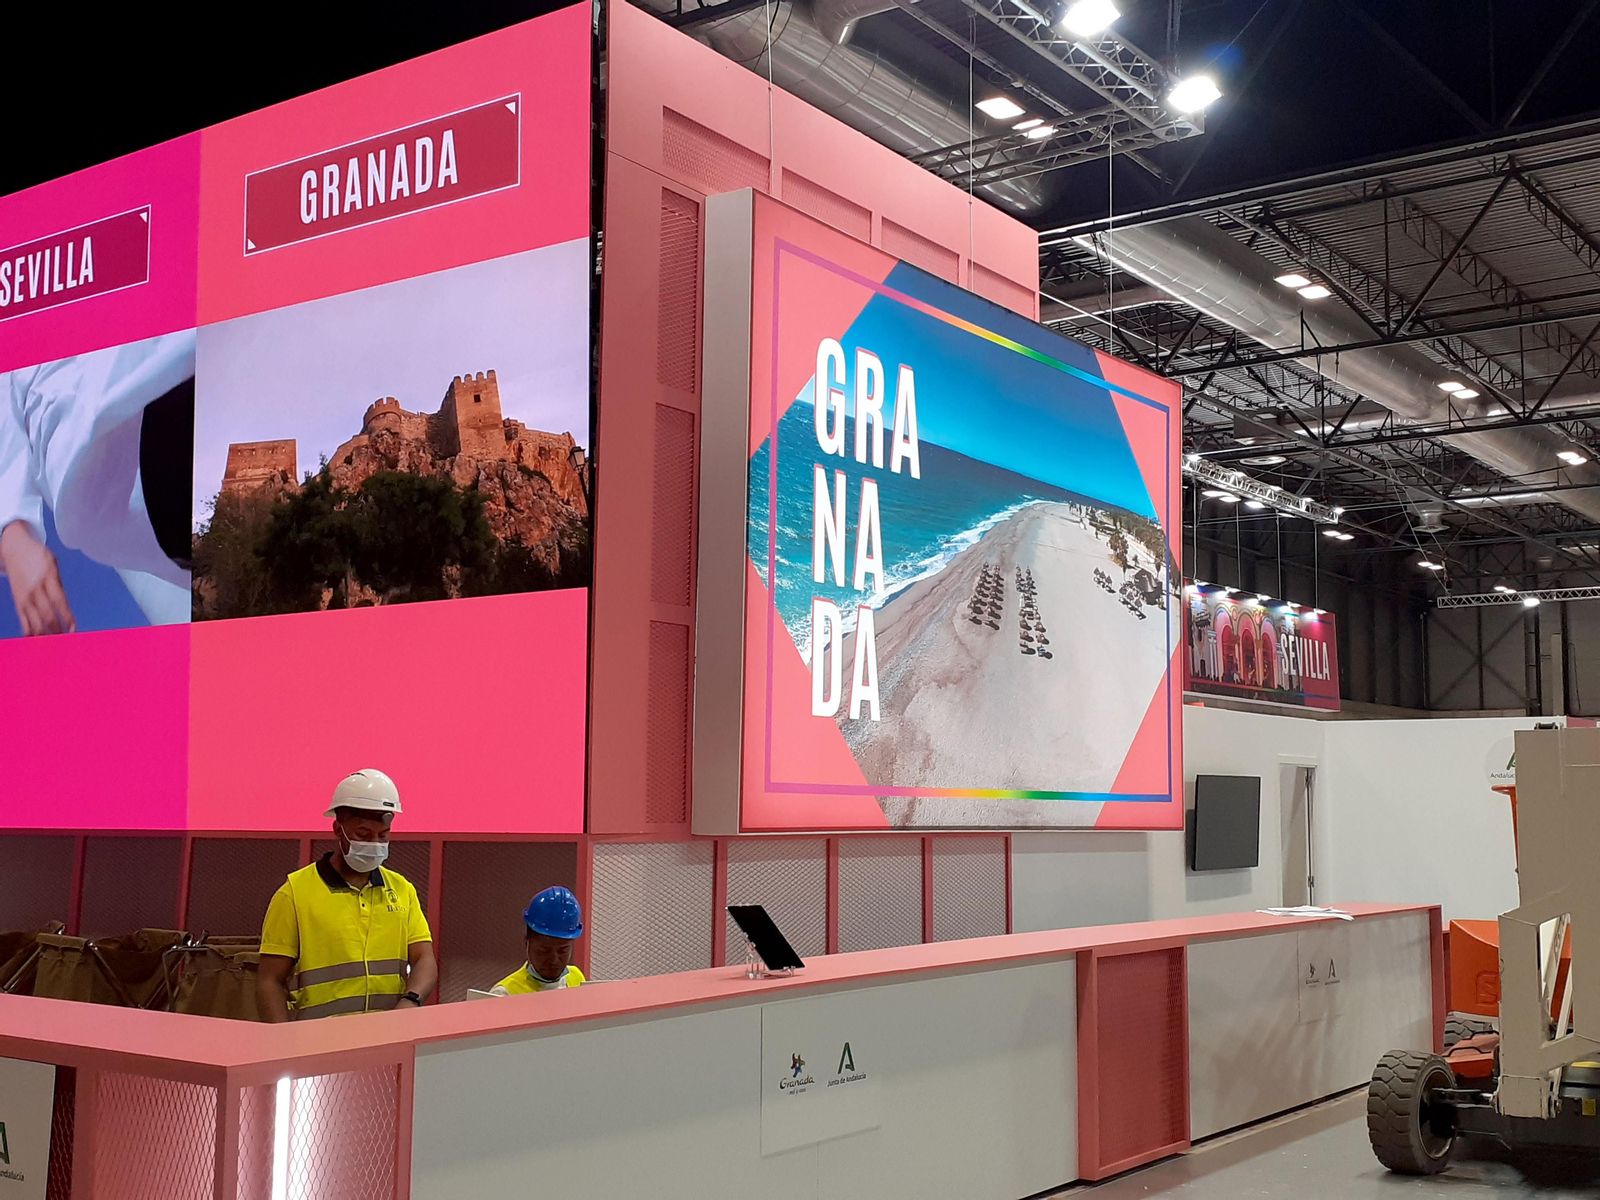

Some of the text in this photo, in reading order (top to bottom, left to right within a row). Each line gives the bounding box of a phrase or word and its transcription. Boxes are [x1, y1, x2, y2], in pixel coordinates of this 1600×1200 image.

[300, 129, 458, 224] GRANADA
[0, 236, 94, 307] SEVILLA
[814, 337, 921, 480] GRA
[812, 463, 884, 594] NA
[810, 597, 881, 722] DA
[1280, 633, 1331, 681] SEVILLA
[779, 1075, 815, 1089] Granada
[827, 1079, 840, 1088] Junta
[840, 1077, 846, 1085] de
[0, 1169, 24, 1182] ndalucía
